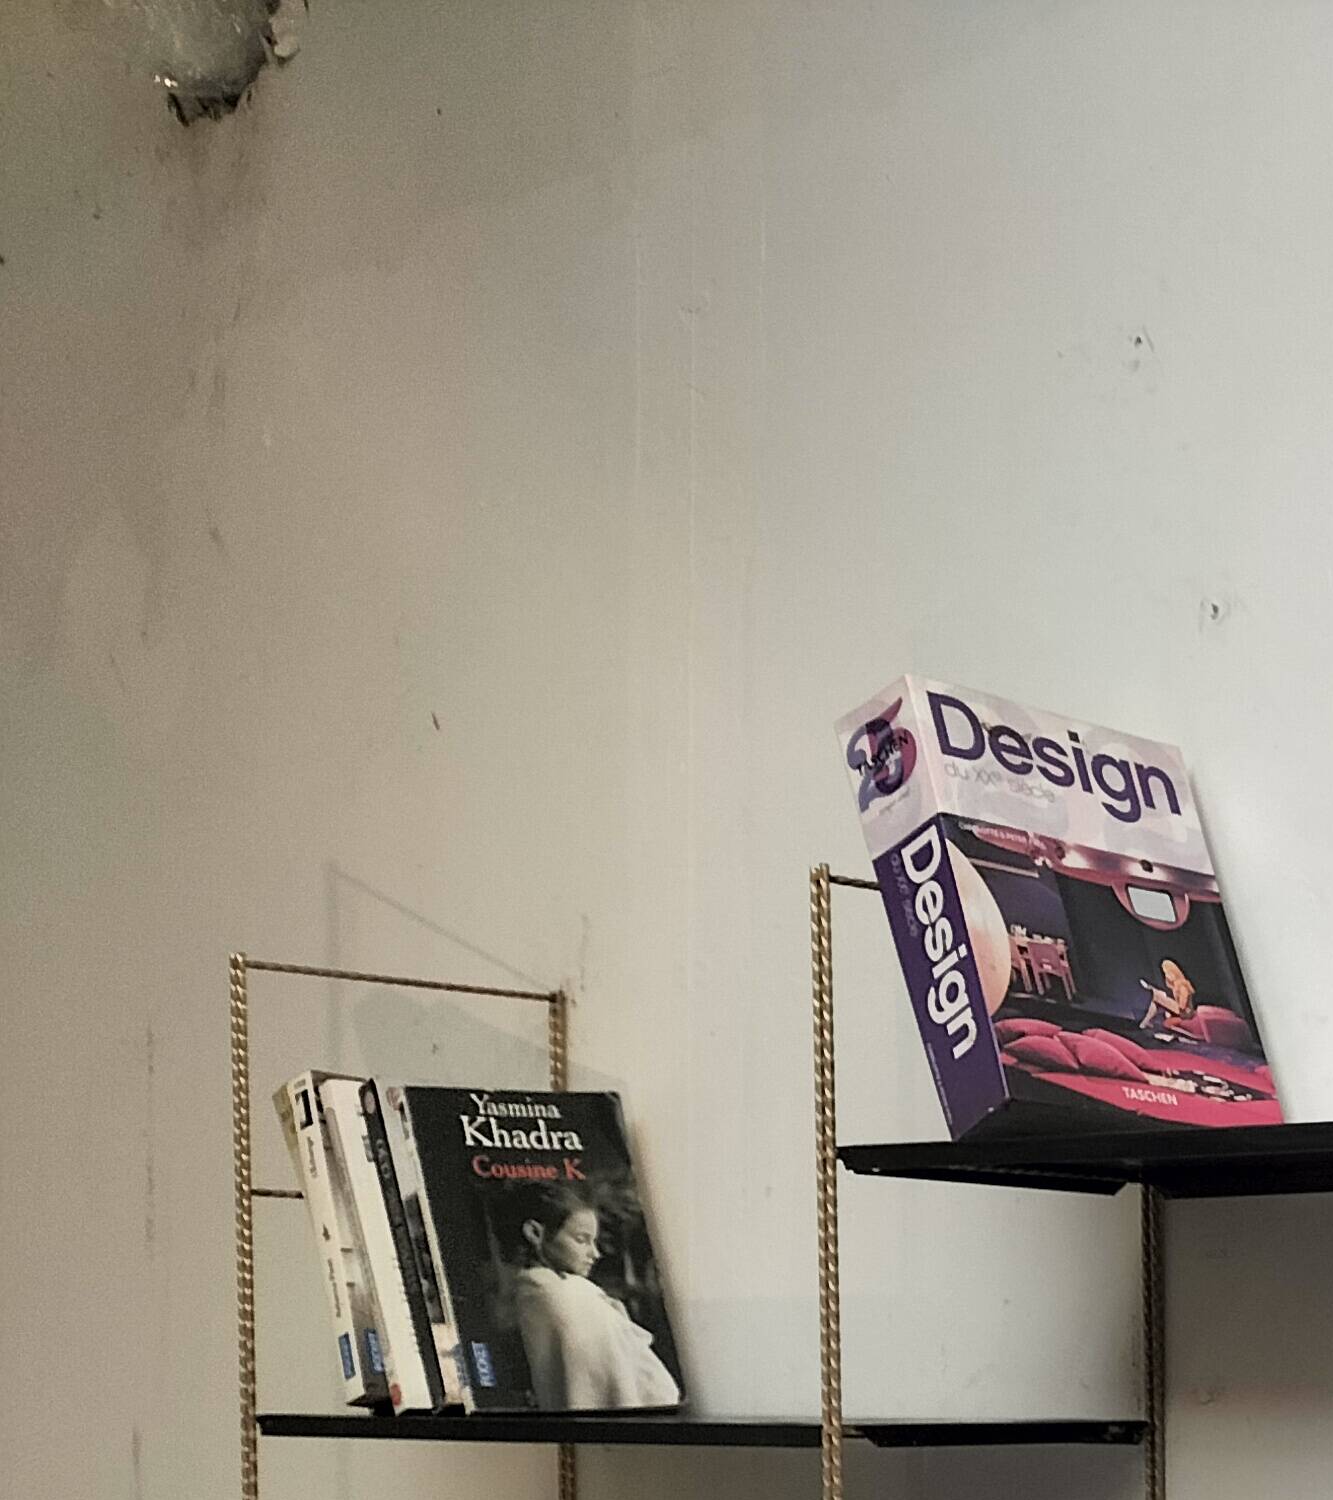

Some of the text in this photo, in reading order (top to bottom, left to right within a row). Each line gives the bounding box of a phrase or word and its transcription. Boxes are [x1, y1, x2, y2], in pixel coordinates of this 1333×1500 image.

[926, 690, 1182, 823] Design
[900, 824, 978, 1060] Design
[470, 1093, 562, 1118] Yasmina
[1121, 1086, 1179, 1106] TASCHEN
[460, 1114, 584, 1150] Khadra
[471, 1154, 587, 1180] Cousine K
